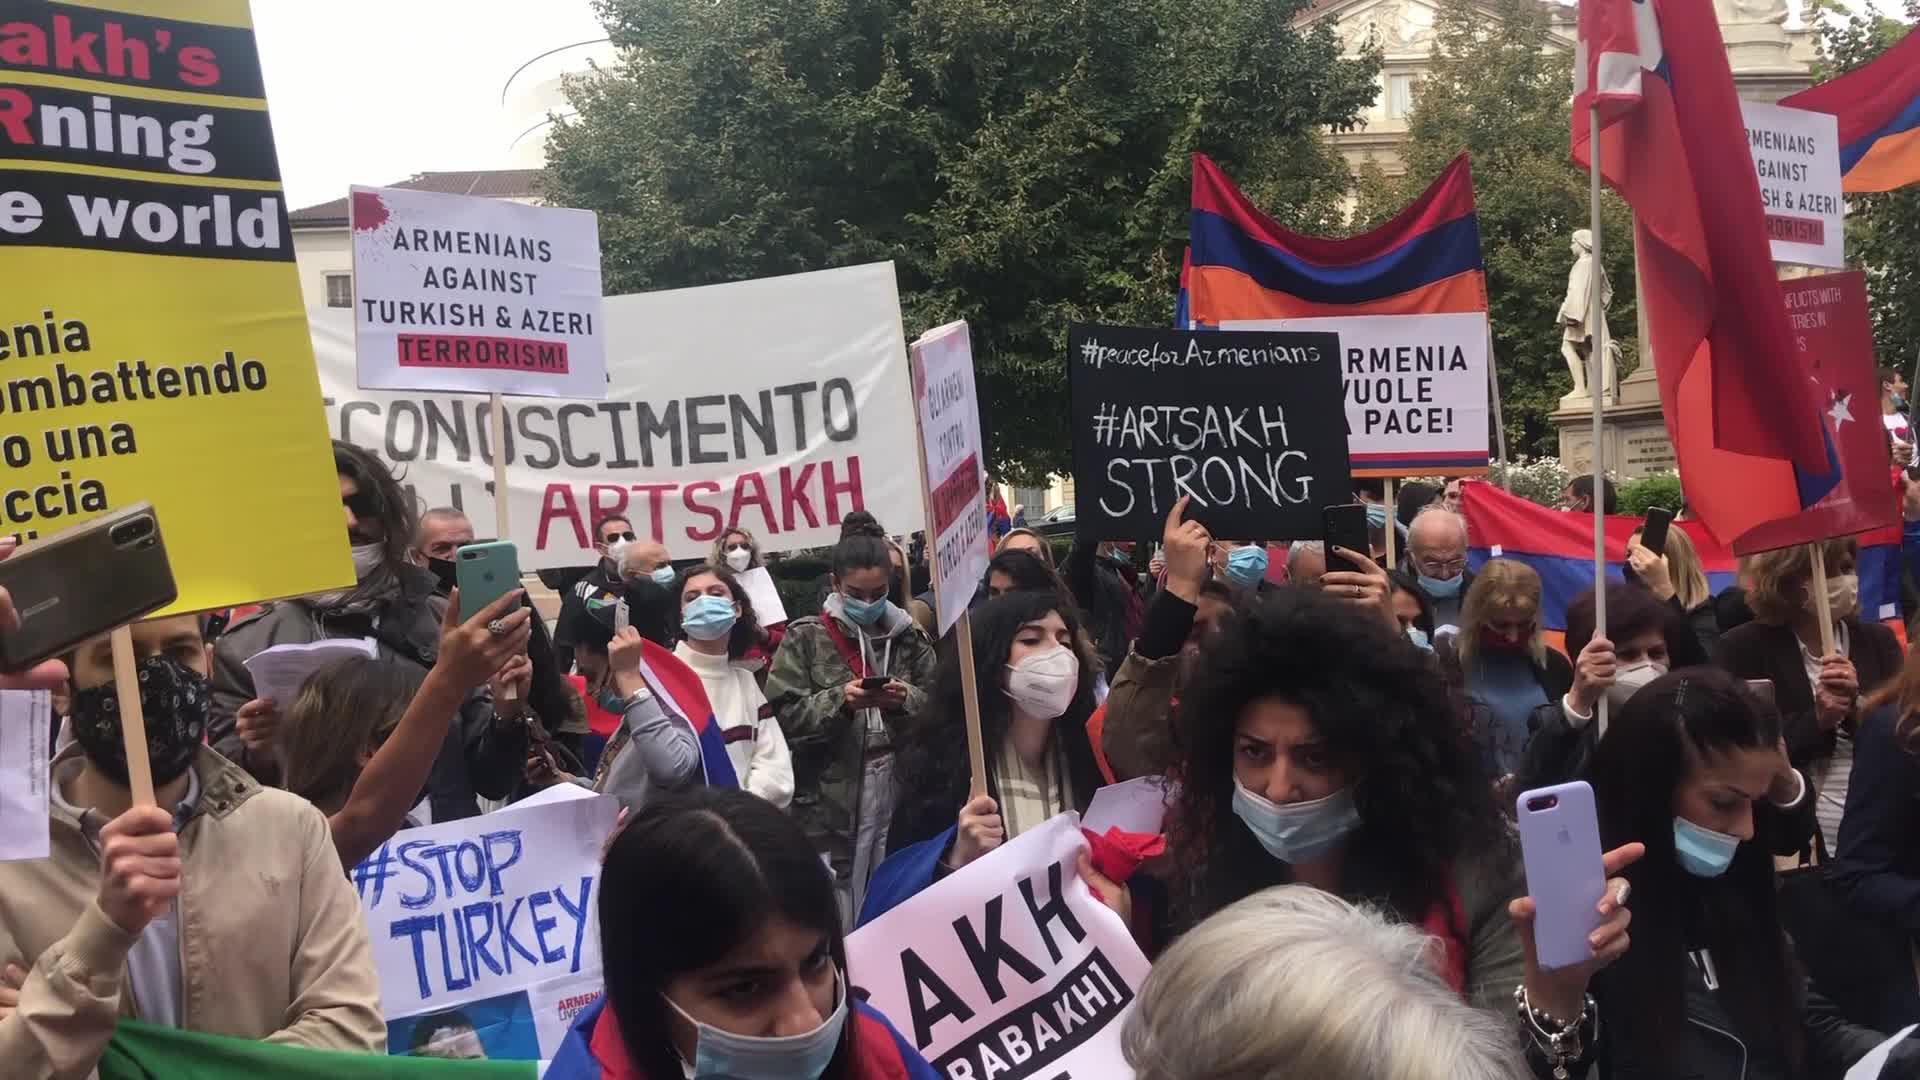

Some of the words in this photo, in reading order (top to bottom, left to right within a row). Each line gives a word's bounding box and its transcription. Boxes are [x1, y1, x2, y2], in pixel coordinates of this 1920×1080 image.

[1758, 159, 1807, 182] GAINST
[0, 191, 44, 234] e
[67, 194, 281, 248] world
[1785, 191, 1794, 209] &
[1799, 193, 1837, 214] AZERI
[393, 226, 553, 263] ARMENIANS
[423, 266, 537, 296] AGAINST
[362, 299, 485, 327] TURKISH
[495, 305, 512, 328] &
[521, 308, 593, 335] AZERI
[400, 337, 565, 368] TERRORISM!
[1080, 337, 1321, 372] #peaceforArmenians
[1347, 345, 1468, 373] RMENIA
[0, 352, 267, 415] mbattendo
[3, 433, 31, 468] o
[45, 421, 137, 462] una
[323, 377, 858, 471] CONOSCIMENTO
[1093, 402, 1289, 450] #ARTSAKH
[1364, 407, 1453, 435] PACE!
[0, 471, 108, 523] ccia
[535, 456, 866, 549] ARTSAKH
[1100, 451, 1314, 517] STRONG
[353, 830, 523, 910] #STOP
[390, 876, 593, 999] TURKEY
[850, 861, 1088, 1051] AKH
